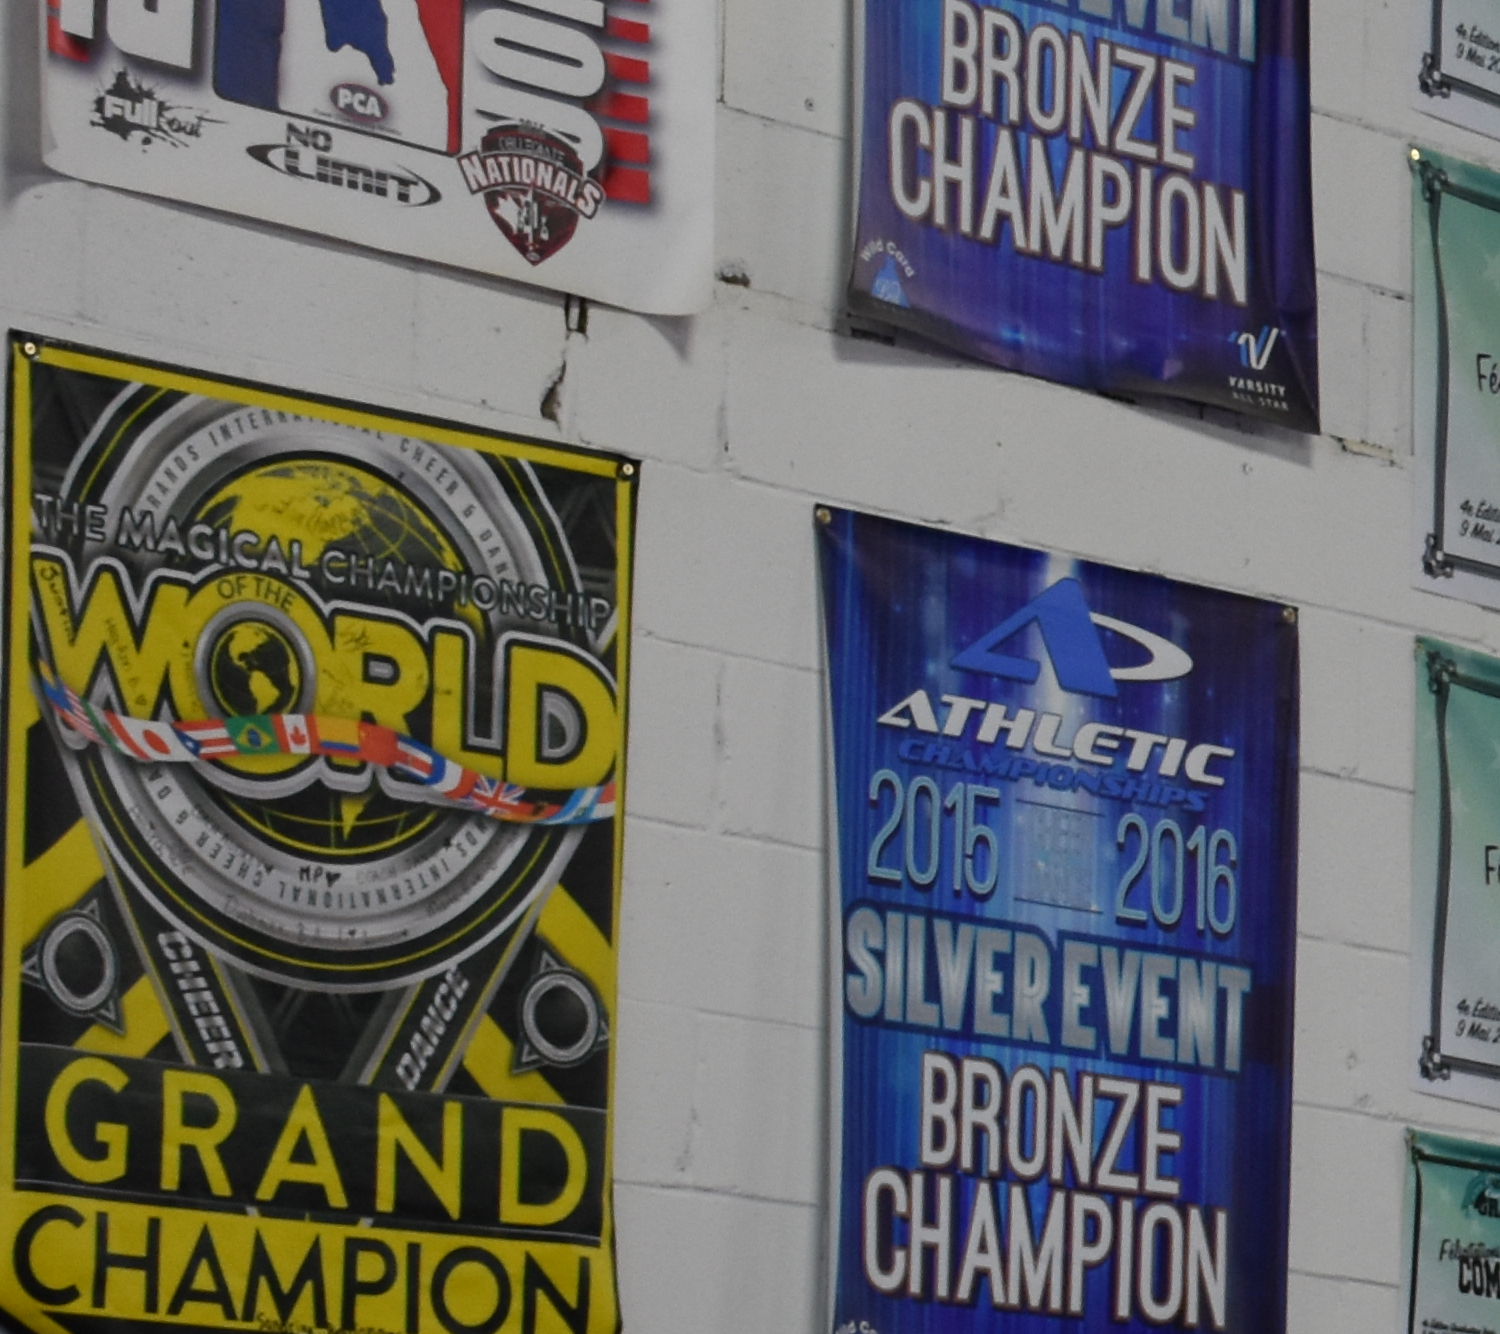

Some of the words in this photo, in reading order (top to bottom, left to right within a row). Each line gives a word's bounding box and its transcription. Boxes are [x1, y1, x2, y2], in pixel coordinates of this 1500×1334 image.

[286, 123, 333, 154] NO
[336, 87, 381, 115] PCA
[459, 152, 603, 219] NATIONALS
[889, 101, 1250, 306] CHAMPION
[119, 508, 318, 584] MAGICAL
[320, 548, 615, 632] CHAMPIONSHIP
[217, 578, 247, 602] OF
[252, 577, 296, 612] THE
[29, 548, 618, 796] WORLD
[877, 688, 1235, 786] ATHLETIC
[898, 738, 1209, 811] CHAMPIONSHIPS
[868, 767, 1001, 899] 2015
[1115, 811, 1238, 936] 2016
[157, 931, 244, 1069] CHEER
[396, 967, 471, 1091] DANCE
[845, 903, 1052, 1045] SILVER
[1060, 950, 1252, 1075] EVENT
[43, 1056, 587, 1229] GRAND
[920, 1050, 1183, 1196] BRONZE
[862, 1167, 1230, 1331] CHAMPION
